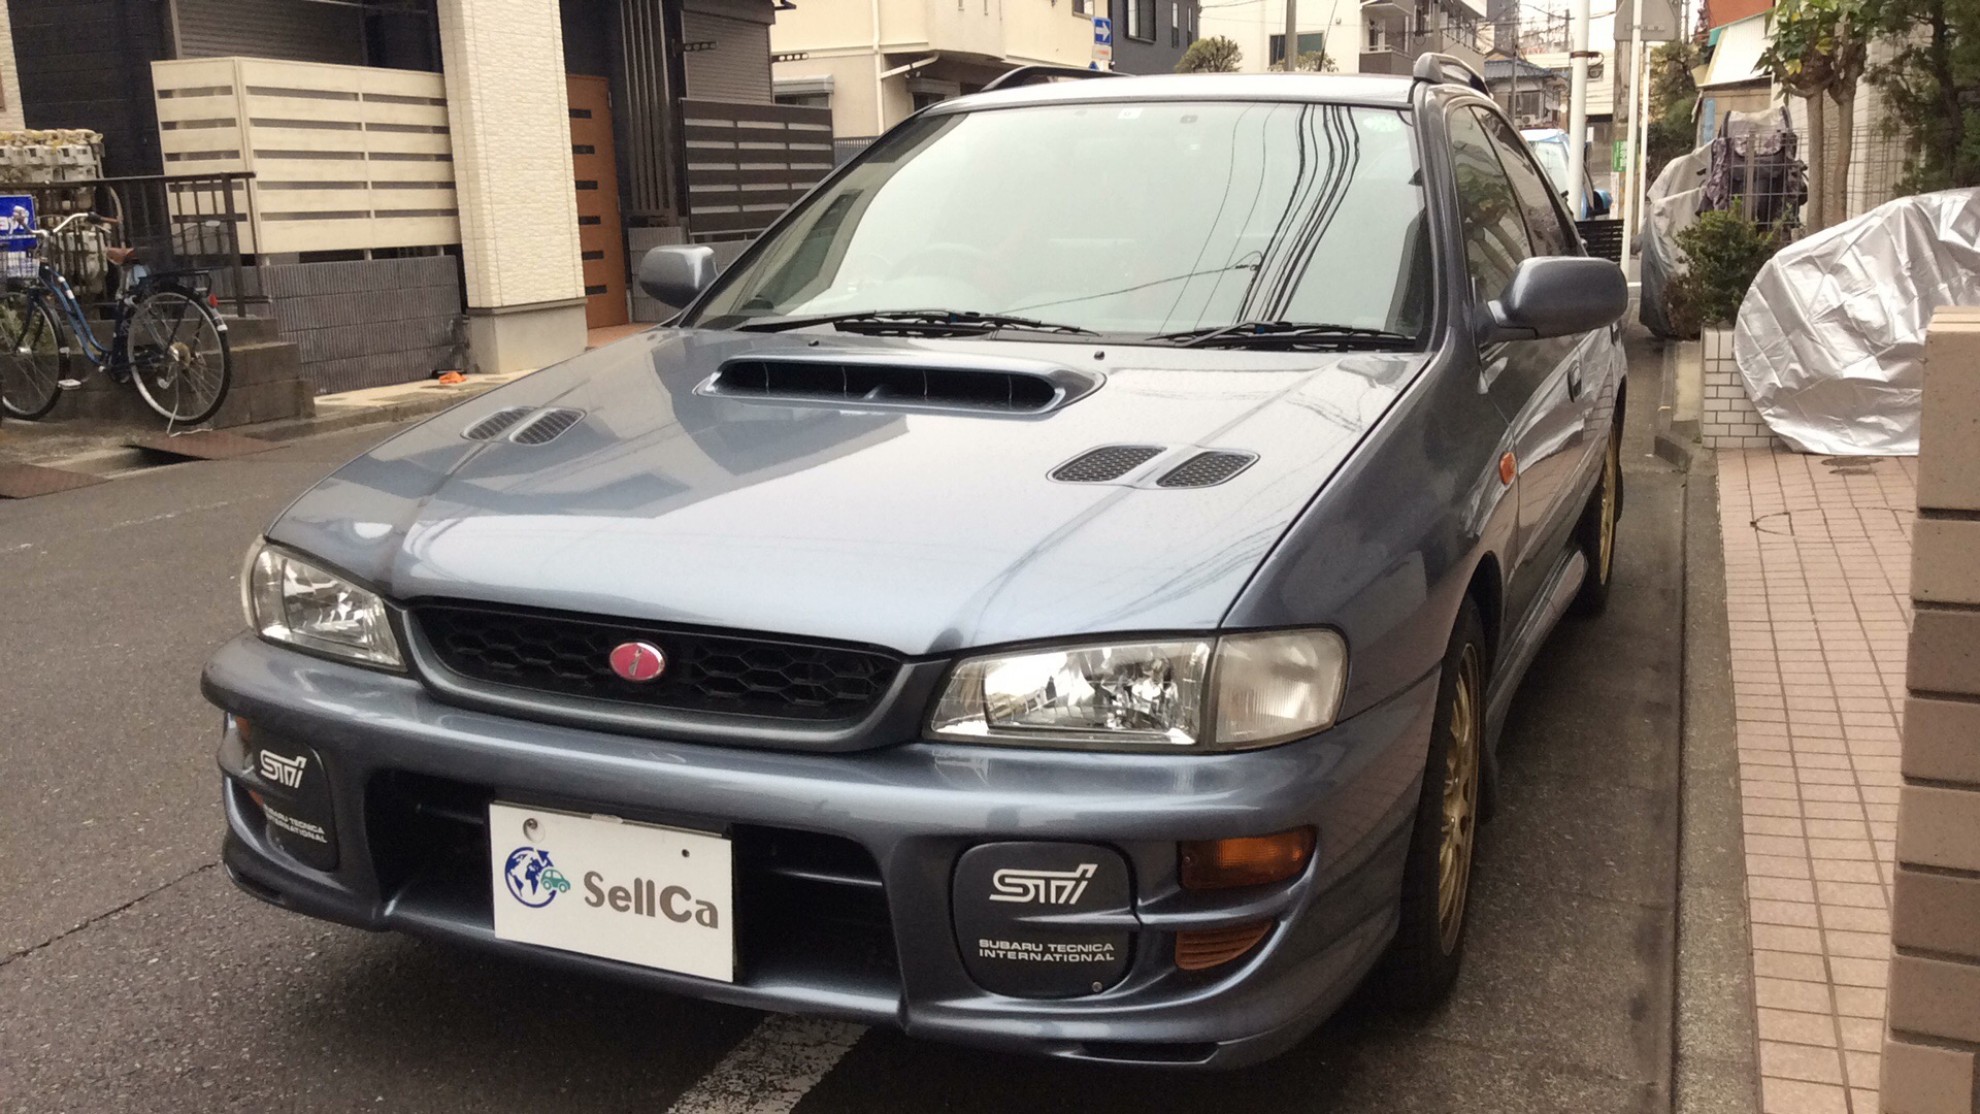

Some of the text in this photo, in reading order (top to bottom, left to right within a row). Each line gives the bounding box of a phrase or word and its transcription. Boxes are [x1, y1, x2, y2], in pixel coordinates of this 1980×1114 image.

[583, 870, 719, 930] SellCa
[979, 939, 1115, 953] SUBARU TECNICA
[979, 949, 1115, 962] INTERNATIONAL
